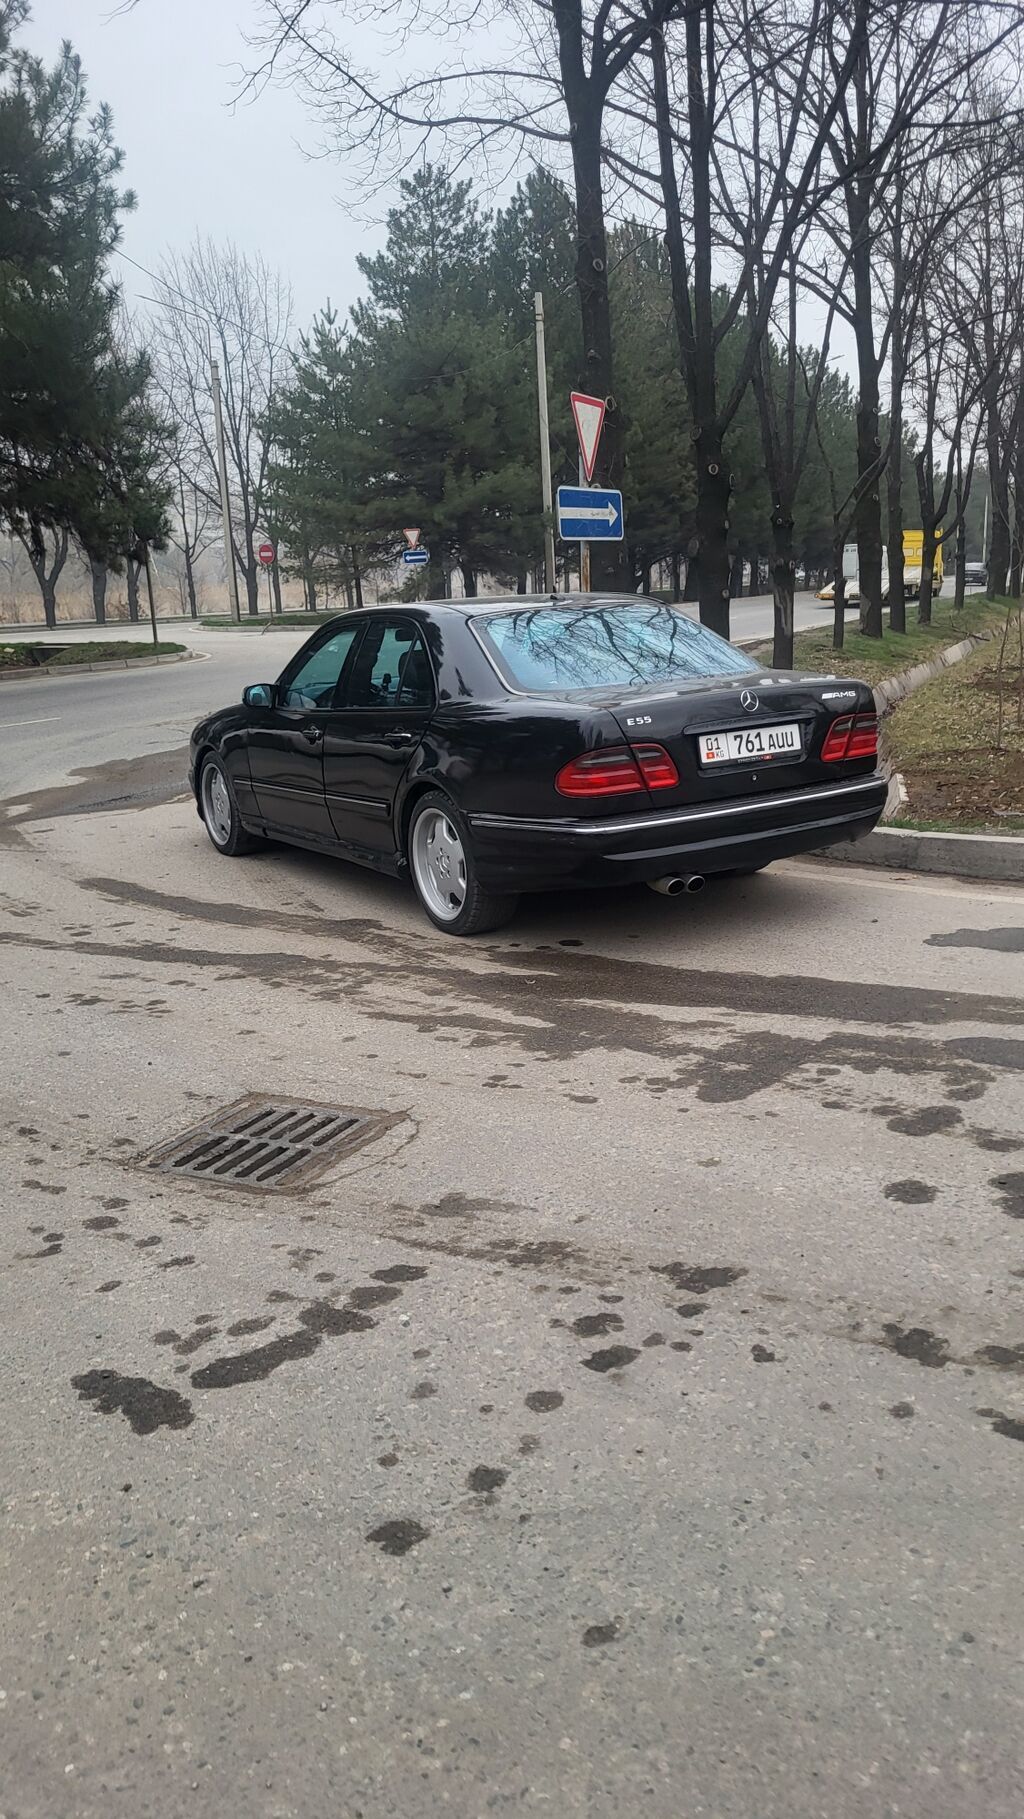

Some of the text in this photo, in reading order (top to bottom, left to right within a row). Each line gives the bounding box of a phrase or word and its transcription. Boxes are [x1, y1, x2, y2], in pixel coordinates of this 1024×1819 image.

[832, 690, 856, 699] AMG
[626, 715, 652, 726] E55
[705, 731, 794, 755] 01 761 AUU
[715, 750, 725, 758] KG
